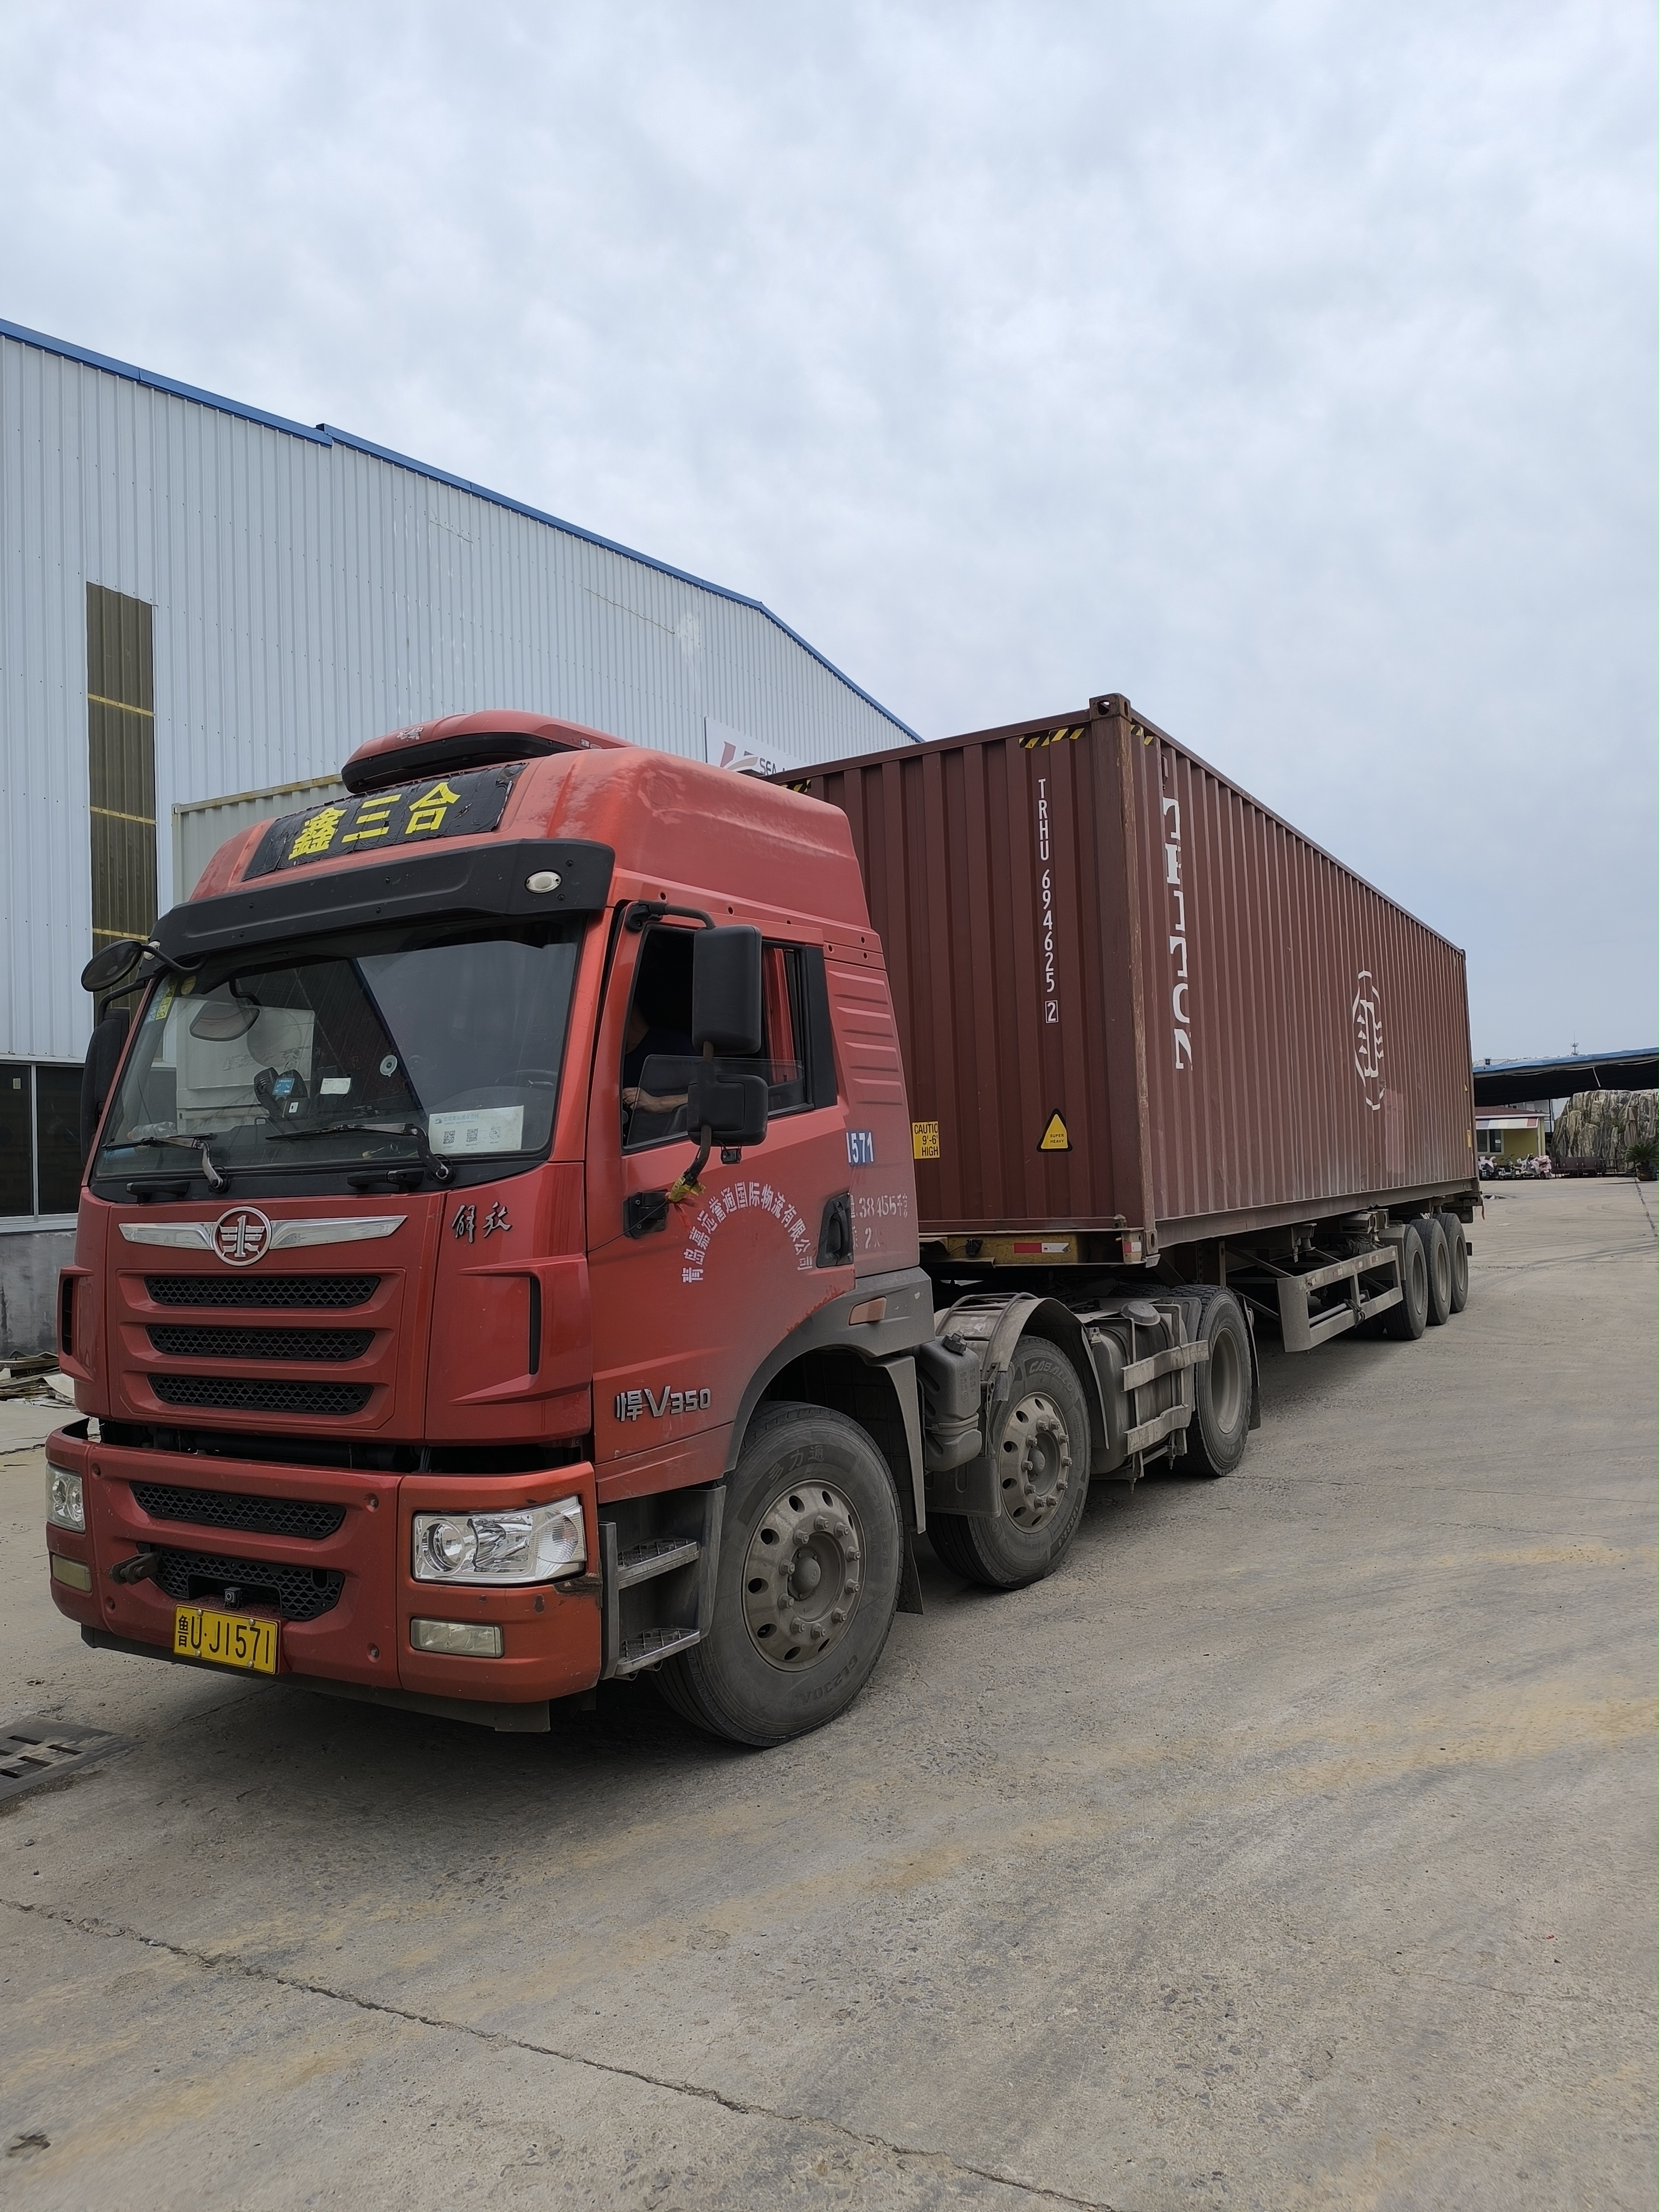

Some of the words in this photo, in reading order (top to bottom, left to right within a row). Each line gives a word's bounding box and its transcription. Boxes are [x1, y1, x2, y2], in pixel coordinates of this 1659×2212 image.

[288, 781, 461, 861] 鑫三合
[1038, 779, 1050, 861] TRHU
[1041, 869, 1054, 993] 694625
[1046, 1001, 1057, 1023] 2
[846, 1131, 874, 1163] 1571
[922, 1146, 938, 1156] HIGH
[1028, 1360, 1074, 1392] CABALLO
[768, 1444, 825, 1488] 多力通
